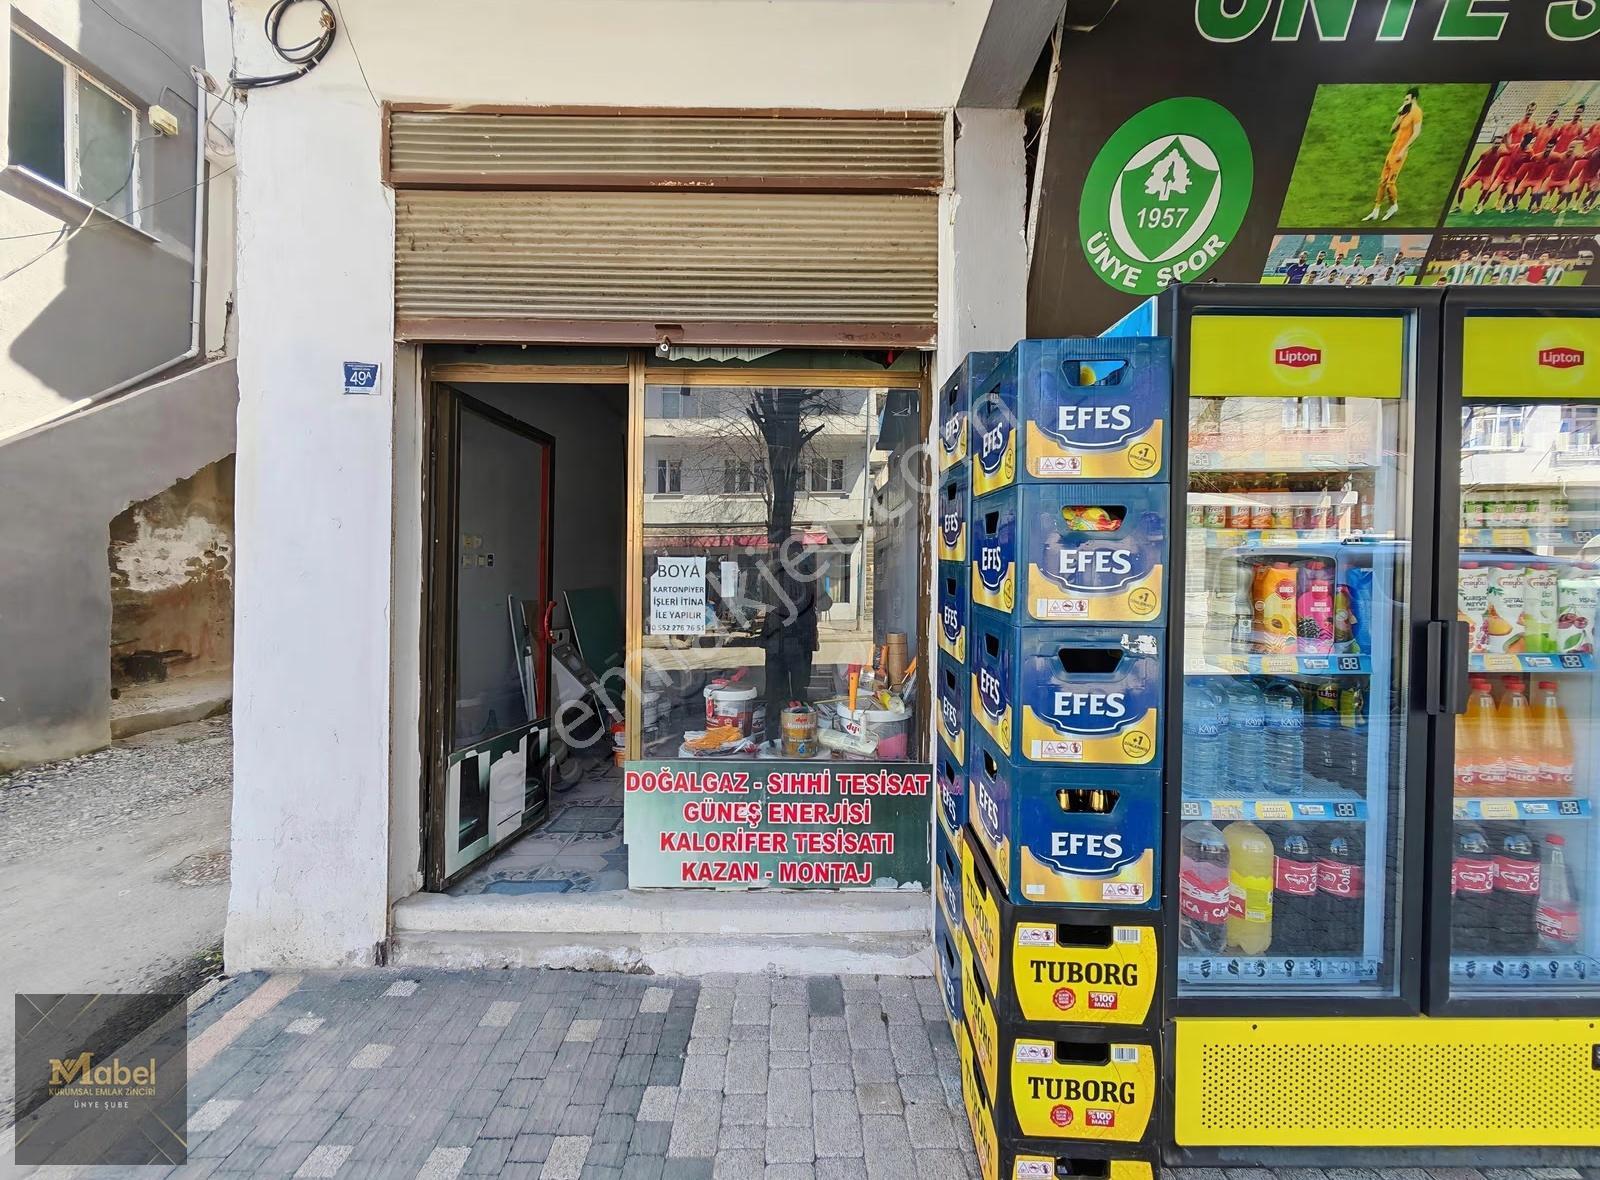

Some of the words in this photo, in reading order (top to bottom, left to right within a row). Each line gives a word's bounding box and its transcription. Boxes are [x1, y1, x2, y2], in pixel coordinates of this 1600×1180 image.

[1136, 207, 1189, 229] 1957
[1086, 231, 1142, 288] ÜNYE
[1156, 234, 1226, 287] SPOR
[1279, 349, 1317, 364] Lipton
[1542, 351, 1581, 365] Lipton
[1058, 404, 1132, 431] EFES
[983, 422, 1003, 458] EFES
[944, 512, 958, 533] EFES
[658, 564, 700, 578] BOYA
[982, 546, 1001, 572] EFES
[1059, 549, 1132, 575] EFES
[653, 596, 678, 607] İŞLERİ
[680, 596, 704, 606] İTİNA
[655, 611, 667, 619] İLE
[944, 604, 958, 629] EFES
[980, 667, 1001, 705] EFES
[943, 695, 957, 728] EFES
[1054, 691, 1127, 718] EFES
[625, 767, 749, 795] DOĞALGAZ
[767, 769, 831, 795] SIHHİ
[836, 769, 931, 796] TESİSAT
[683, 798, 762, 828] GÜNEŞ
[768, 798, 871, 825] ENERJİSİ
[979, 781, 998, 830] EFES
[659, 827, 788, 854] KALORİFER
[793, 828, 894, 855] TESİSATI
[1051, 832, 1123, 859] EFES
[681, 861, 759, 882] KAZAN
[778, 861, 872, 884] MONTAJ
[1030, 960, 1138, 987] TUBORG
[1027, 1076, 1135, 1105] TUBORG
